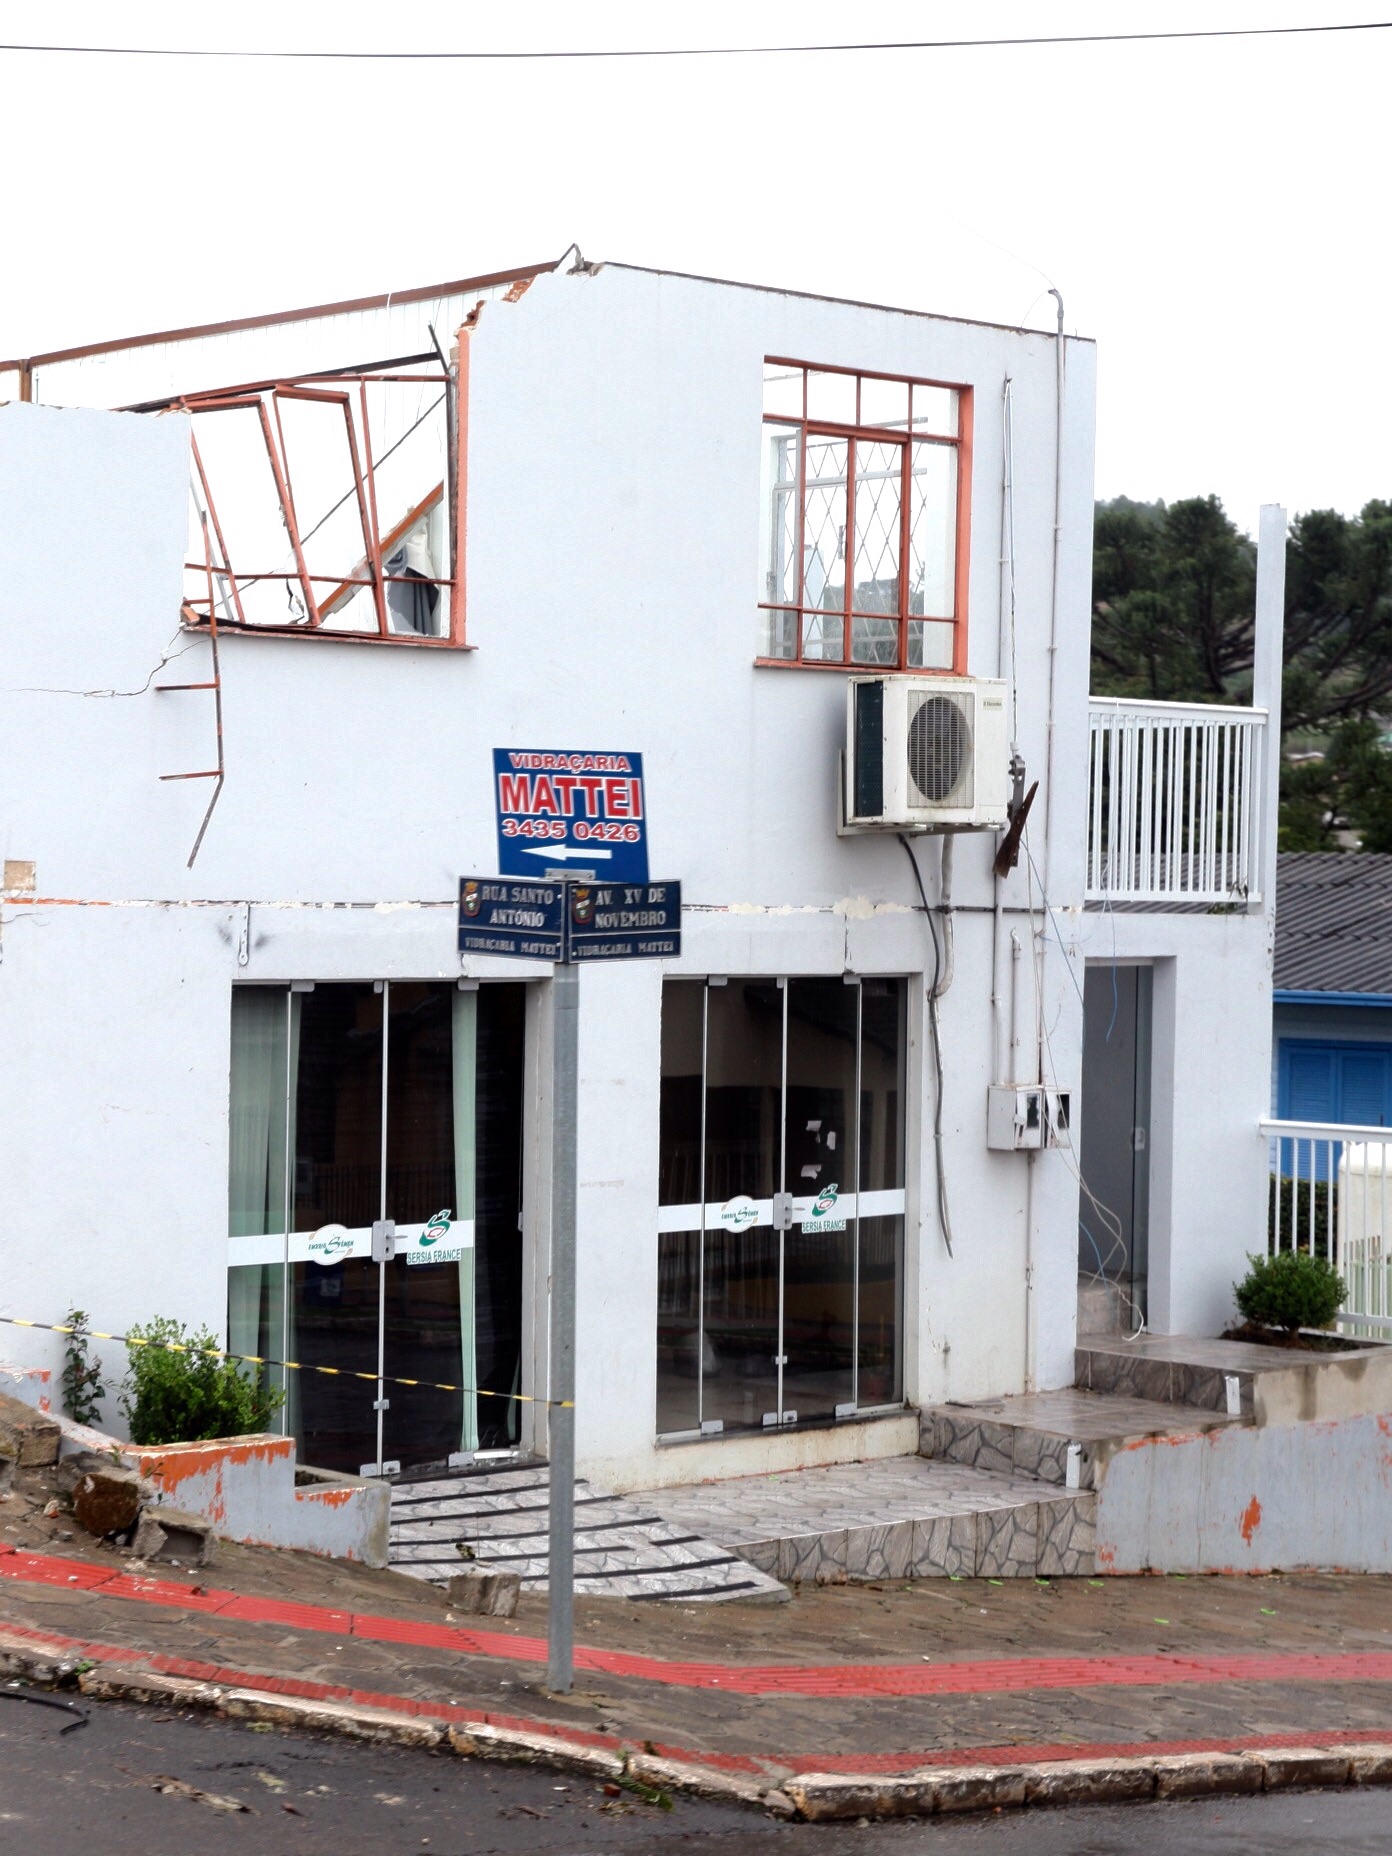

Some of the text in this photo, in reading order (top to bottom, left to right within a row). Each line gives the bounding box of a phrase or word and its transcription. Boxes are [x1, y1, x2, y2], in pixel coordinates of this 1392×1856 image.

[509, 752, 632, 773] VIDRAÇARIA
[499, 773, 643, 820] MATTEI
[502, 819, 641, 841] 3435 0426
[481, 885, 554, 905] RUA SANTO
[624, 889, 642, 904] XV
[647, 888, 666, 903] DE
[520, 941, 556, 955] MATTEI
[637, 941, 674, 953] MATTEI
[802, 1219, 846, 1232] SERSIA FRANCE
[407, 1249, 461, 1264] SERSIA FRANCE
